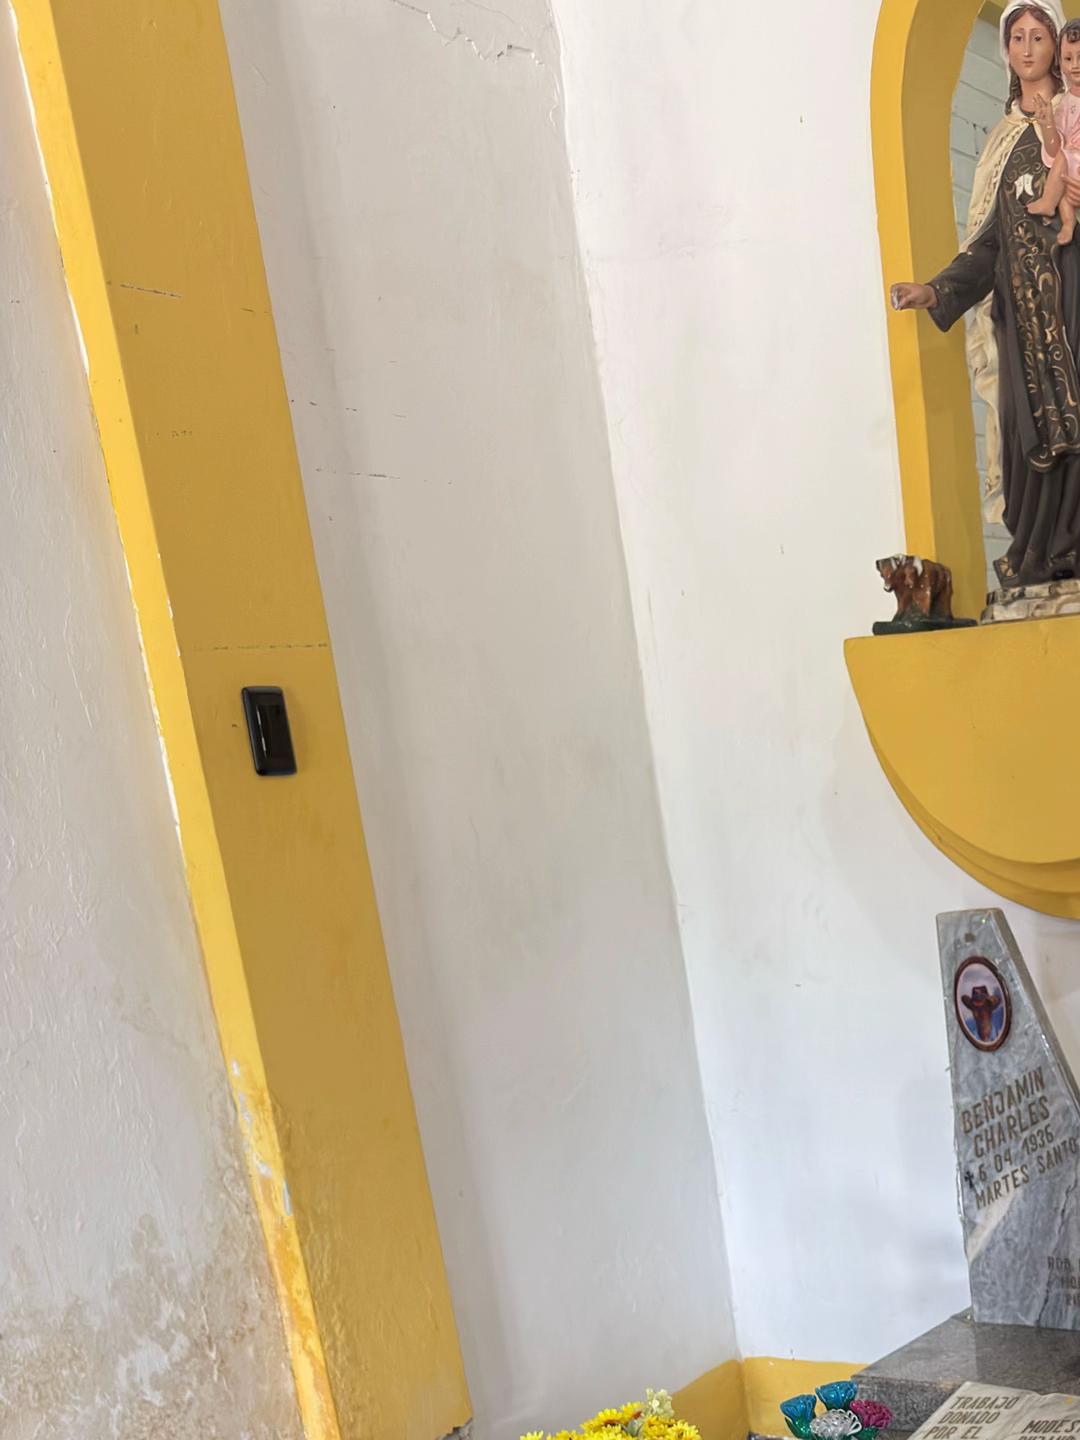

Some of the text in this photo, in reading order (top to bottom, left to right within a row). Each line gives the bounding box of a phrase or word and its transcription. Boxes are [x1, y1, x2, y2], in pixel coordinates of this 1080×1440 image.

[961, 1066, 1046, 1135] BENJAMIN
[973, 1095, 1051, 1158] CHARLES
[975, 1137, 1079, 1210] MARTES SANTO
[978, 1123, 1054, 1182] 6 04 1936
[938, 1410, 1001, 1425] DONADO
[950, 1396, 1020, 1410] TRABAJO
[923, 1426, 983, 1440] POR EL
